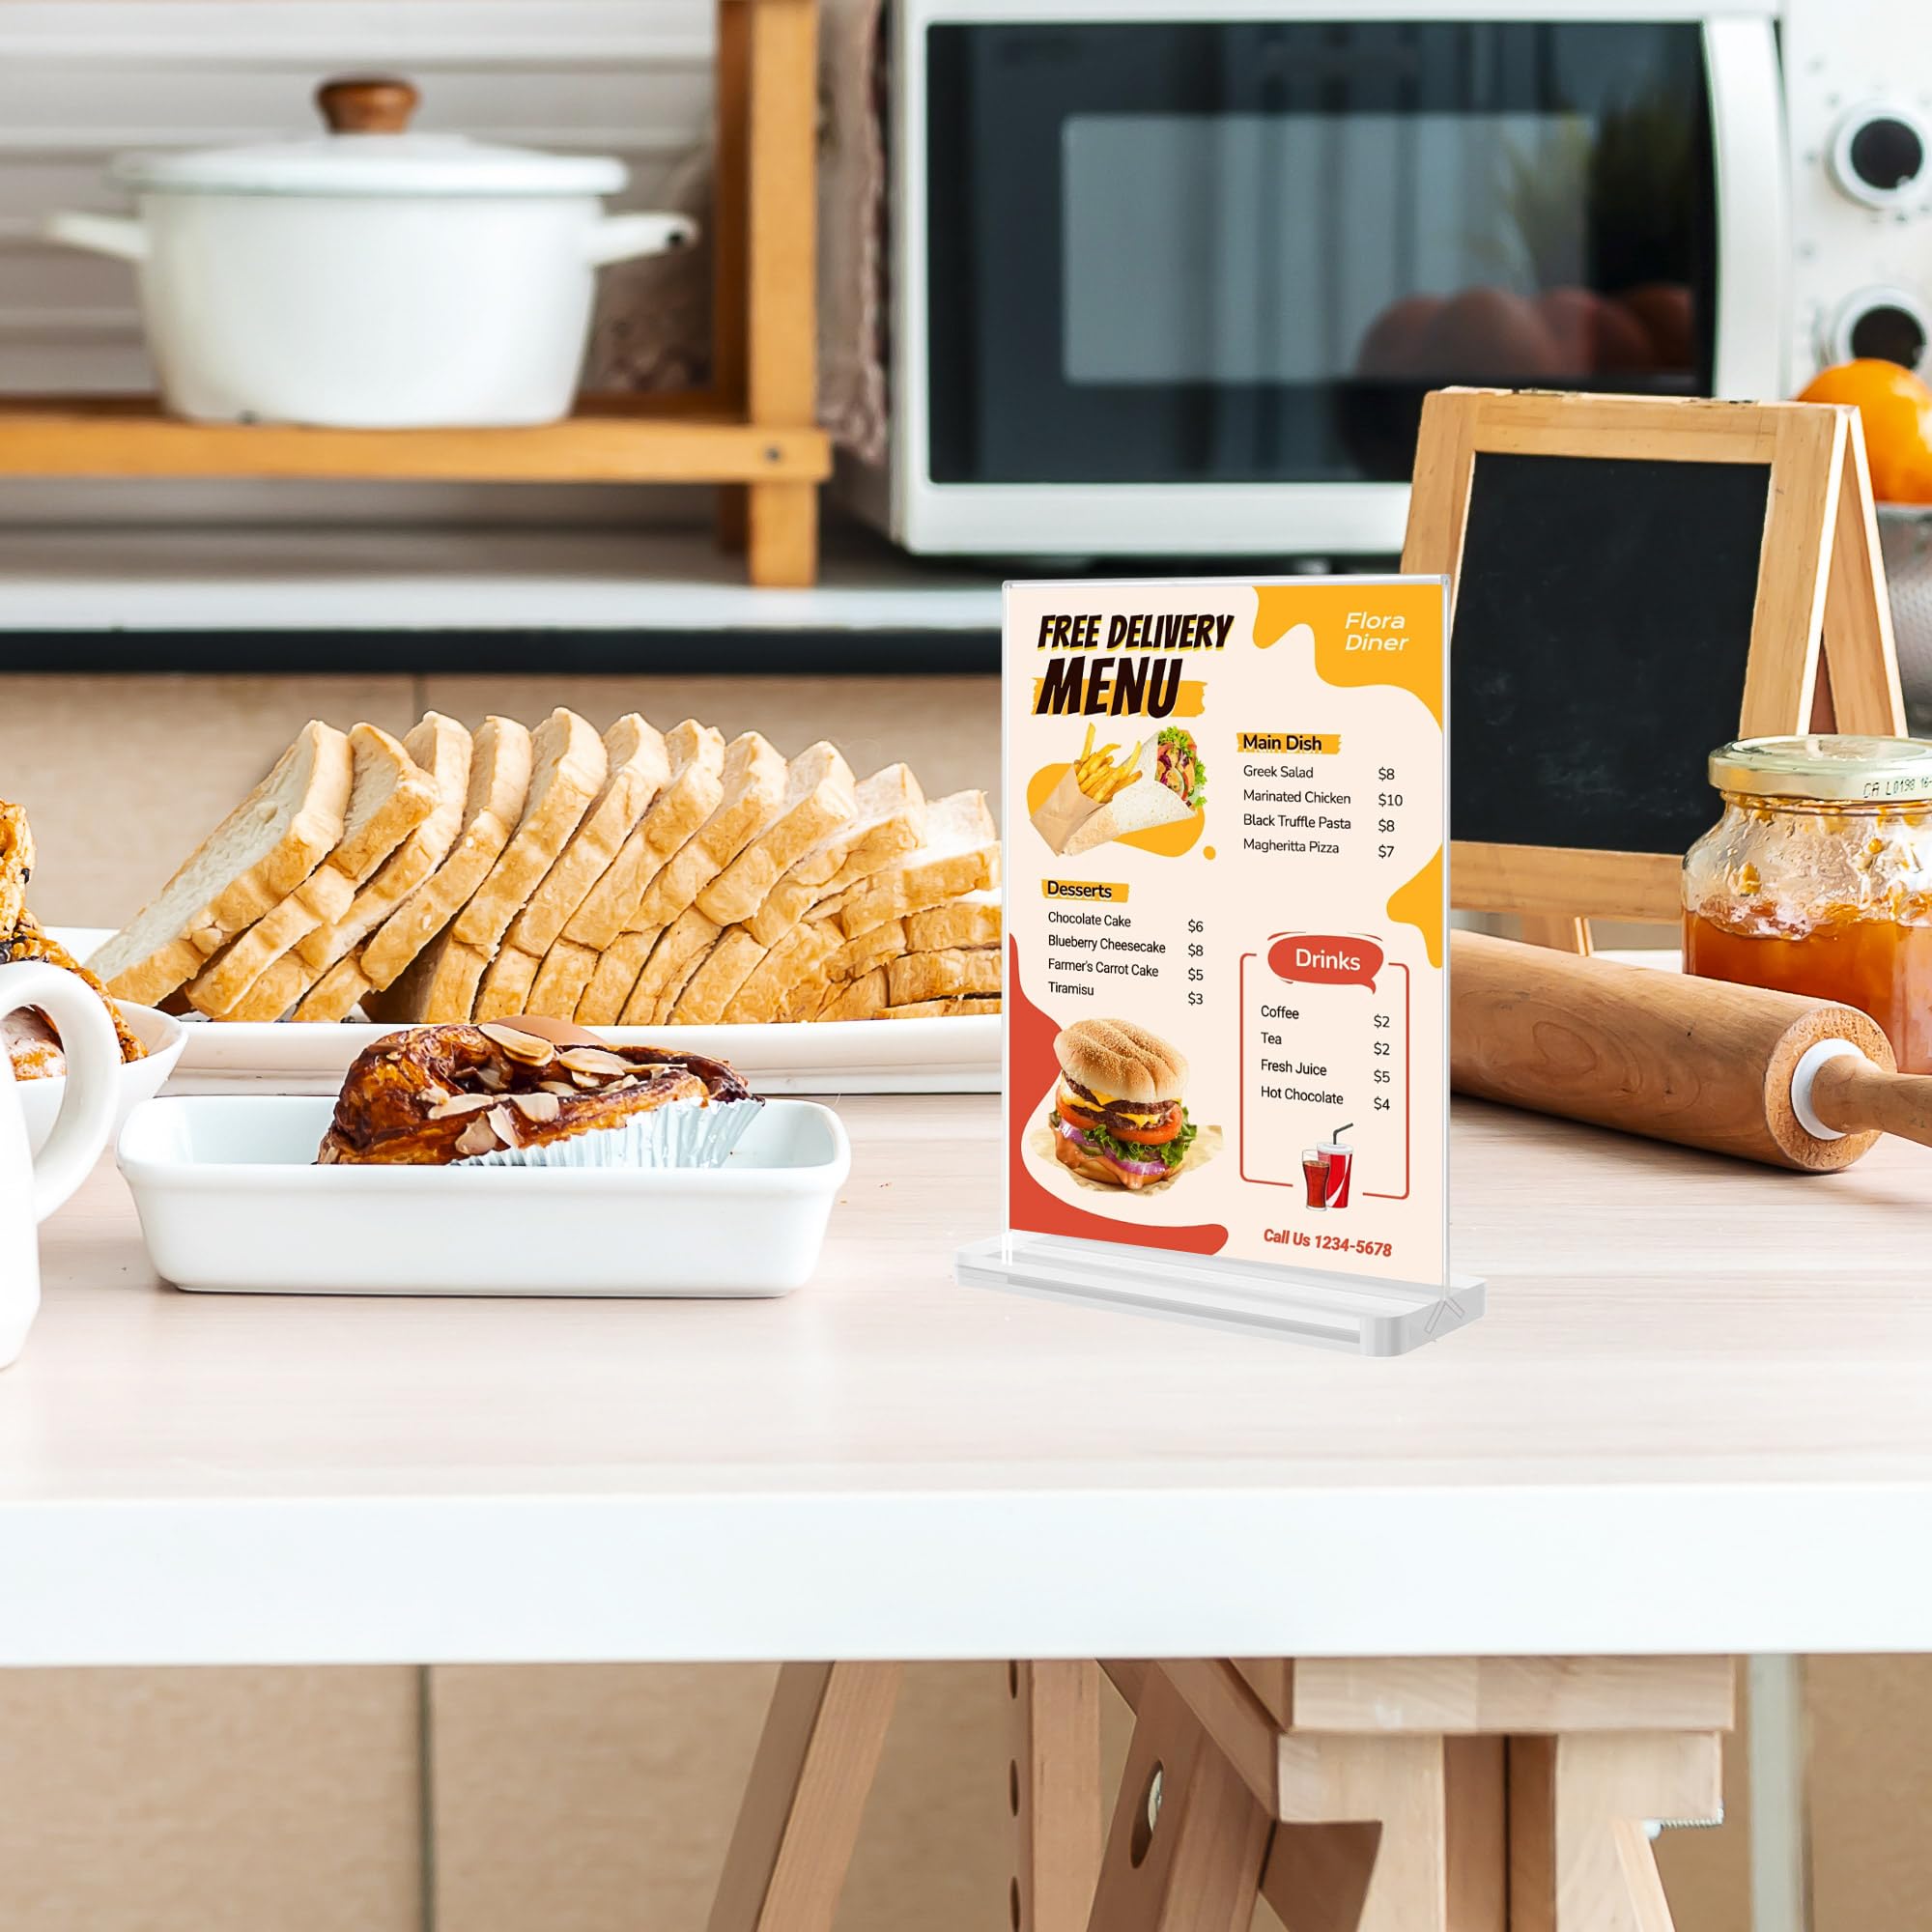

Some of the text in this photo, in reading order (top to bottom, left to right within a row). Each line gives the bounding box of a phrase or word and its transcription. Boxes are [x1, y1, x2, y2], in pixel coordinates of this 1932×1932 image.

[1037, 614, 1235, 648] FREE DELIVERY
[1346, 612, 1405, 628] Flora
[1346, 634, 1407, 650] Diner
[1036, 656, 1182, 718] MENU
[1244, 734, 1321, 751] Main Dish
[1244, 765, 1395, 781] Greek Salad $8
[1244, 789, 1403, 807] Marinated Chicken $10
[1244, 813, 1395, 833] Black Truffle Pasta $8
[1244, 838, 1394, 859] Magheritta Pizza $7
[1048, 881, 1112, 897] Desserts
[1048, 911, 1204, 933] Chocolate Cake $6
[1049, 934, 1203, 957] Blueberry Cheesecake $8
[1049, 958, 1204, 981] Farmer's Carrot Cake $5
[1296, 949, 1360, 970] Drinks
[1048, 981, 1203, 1006] Tiramisu $3
[1262, 1006, 1390, 1028] Coffee $2
[1261, 1032, 1390, 1056] Tea $2
[1262, 1059, 1390, 1084] Fresh Juice $5
[1262, 1086, 1390, 1111] Hot Chocolate $4
[1264, 1229, 1392, 1257] Call Us 1234-5678
